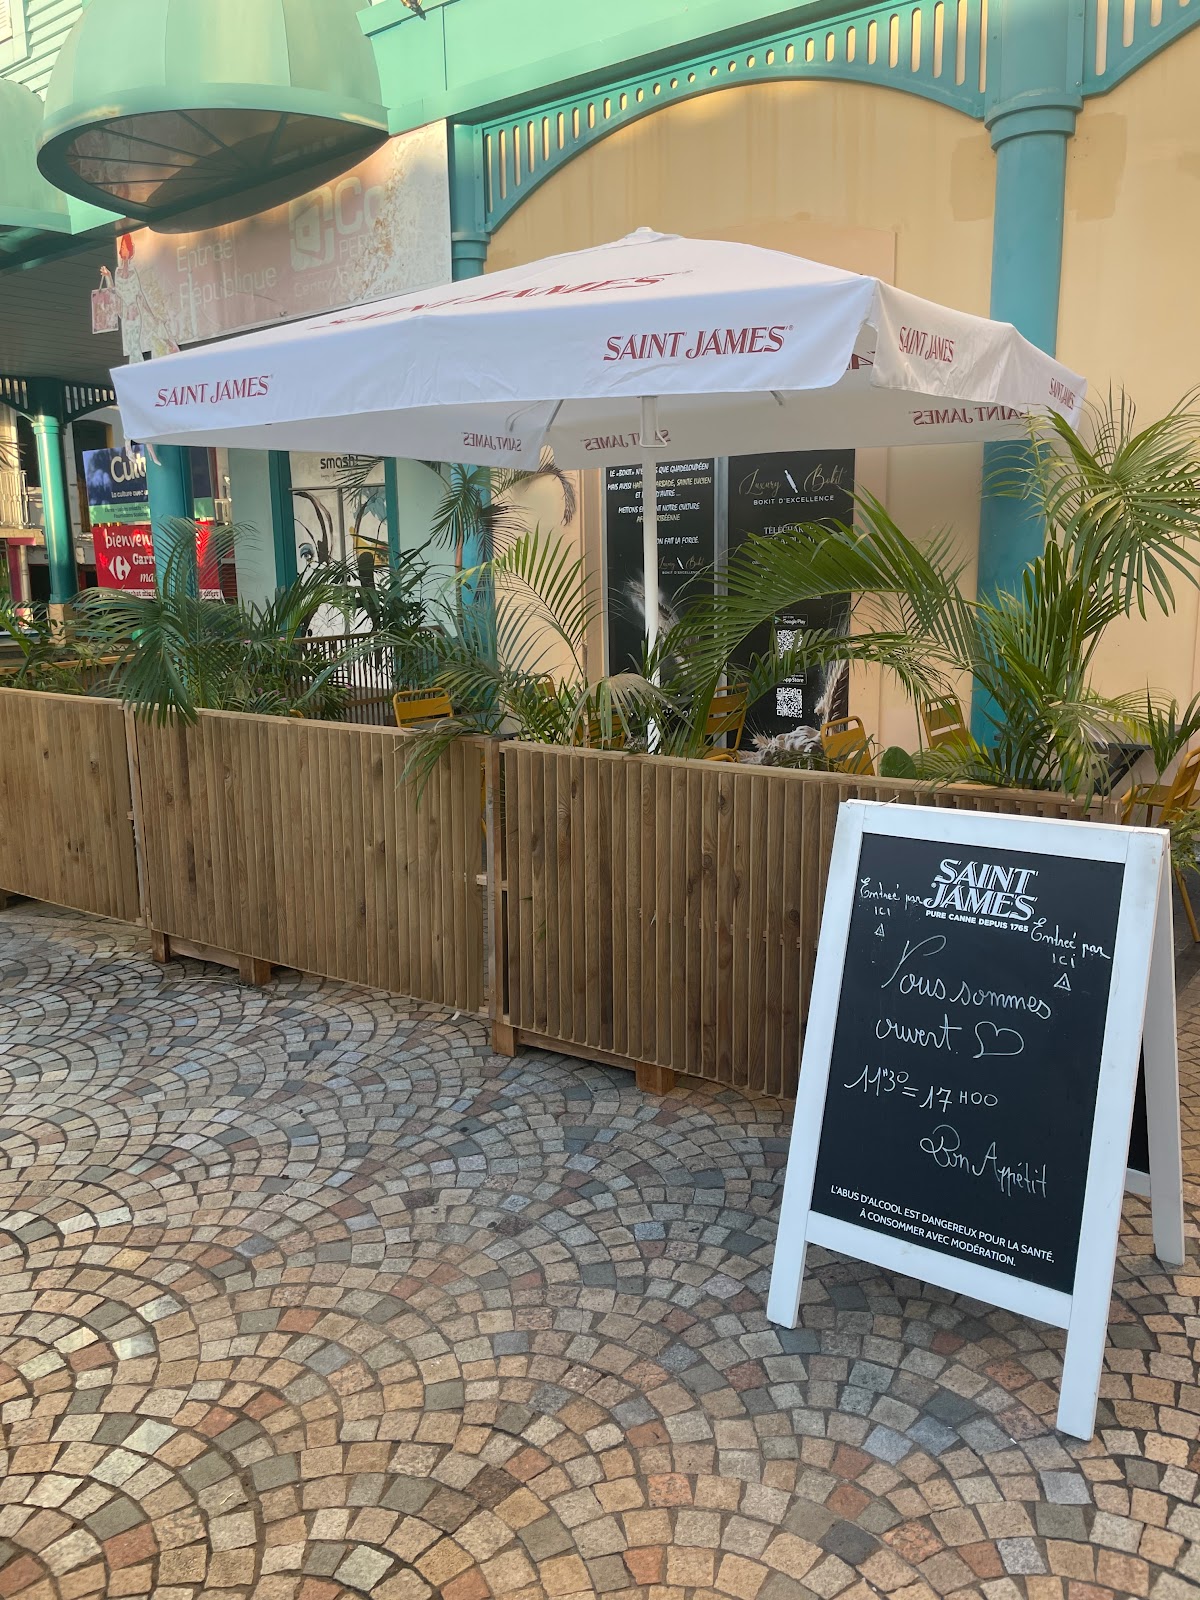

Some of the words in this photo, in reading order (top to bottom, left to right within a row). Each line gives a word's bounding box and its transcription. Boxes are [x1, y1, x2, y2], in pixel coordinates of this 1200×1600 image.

[603, 331, 688, 361] SAINT
[899, 326, 928, 357] SAINT
[925, 334, 955, 363] JAMES
[154, 383, 209, 407] SAINT
[210, 375, 270, 404] JAMES
[1049, 377, 1064, 403] SAINT
[1059, 386, 1077, 410] JAMES
[658, 465, 670, 474] QUE
[738, 468, 782, 498] Luxury
[753, 498, 776, 506] BOKIT
[778, 494, 835, 505] D'EXCELLENCE
[934, 858, 1039, 895] SAINT
[923, 882, 1039, 921] JAMES
[925, 909, 947, 920] PURE
[948, 913, 977, 925] CANNE
[978, 918, 1009, 930] DEPUIS
[1010, 922, 1030, 933] 1765
[949, 980, 1052, 1020] sommes
[919, 1124, 971, 1174] Bon
[830, 1184, 860, 1202] L'ABUS
[860, 1194, 903, 1216] D'ALCOOL
[903, 1206, 922, 1221] EST
[921, 1212, 978, 1240] DANGEREUX
[978, 1230, 1007, 1248] POUR
[1006, 1239, 1020, 1252] LA
[1020, 1243, 1055, 1264] SANTÉ,
[859, 1207, 867, 1219] À
[867, 1210, 926, 1238] CONSOMMER
[925, 1229, 950, 1246] AVEC
[950, 1237, 1017, 1267] MODÉRATION.
